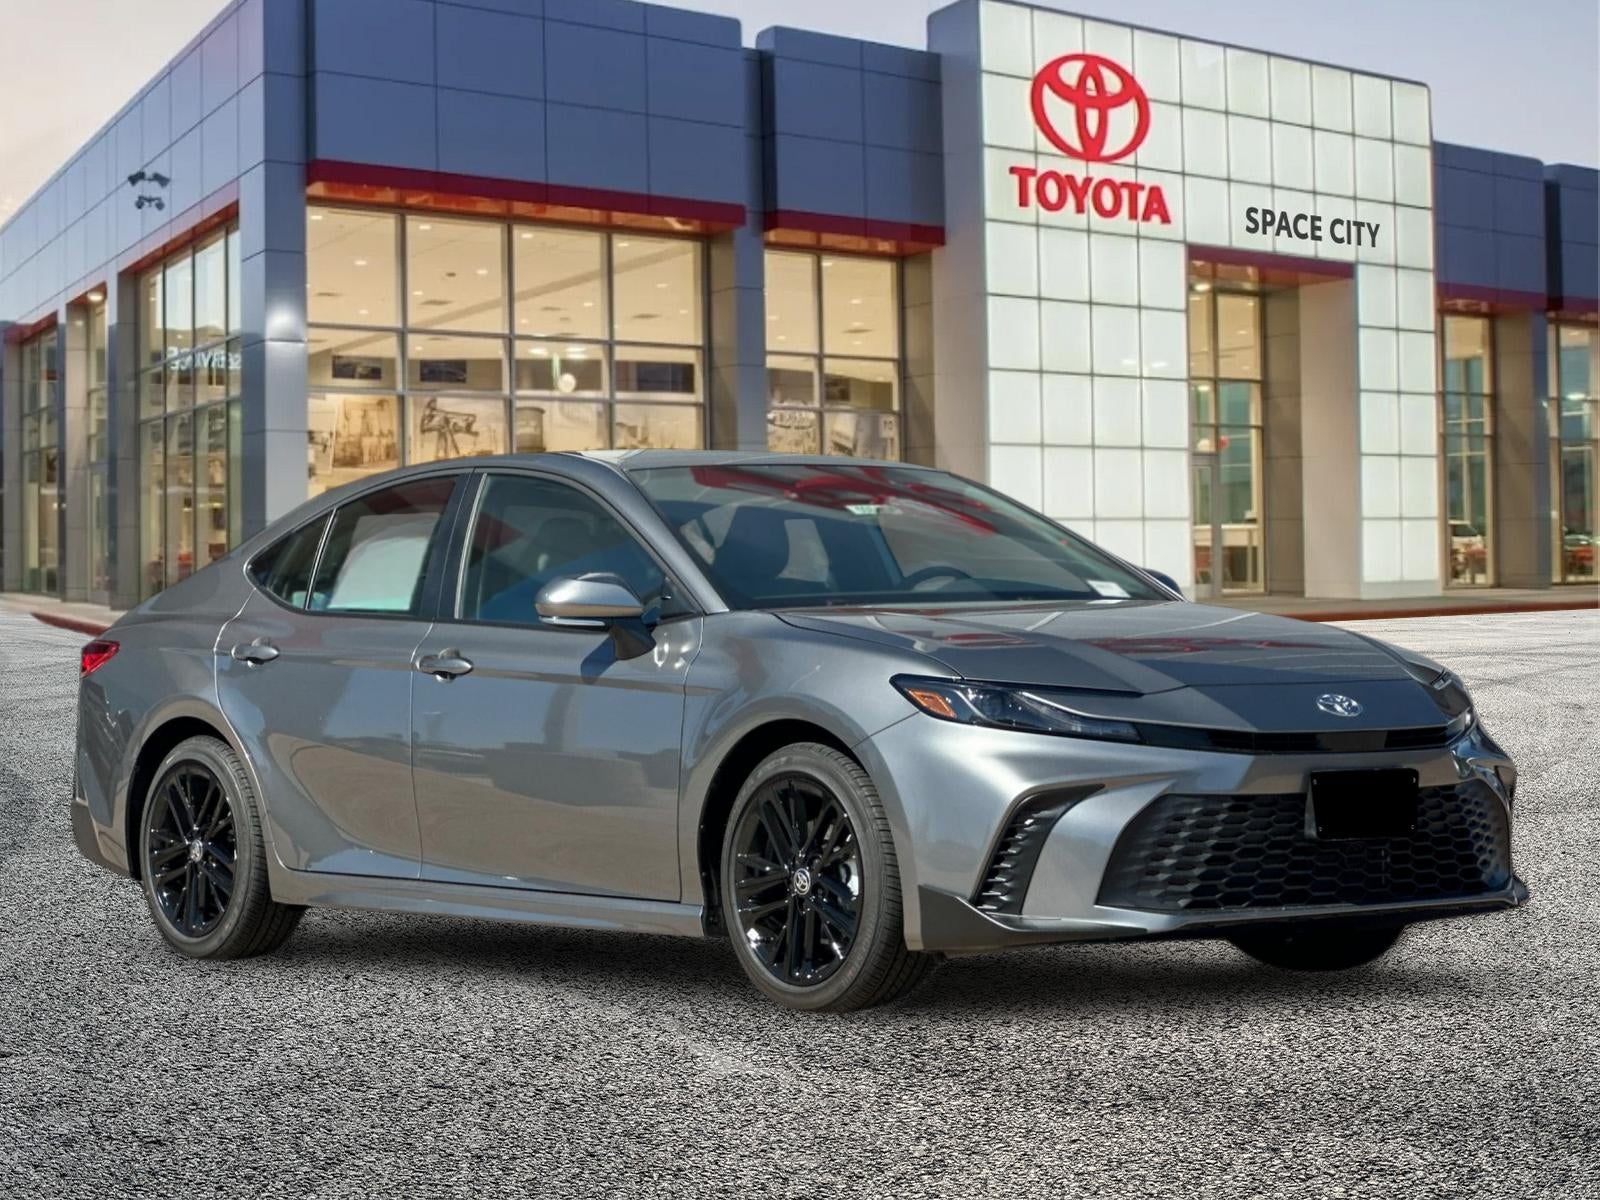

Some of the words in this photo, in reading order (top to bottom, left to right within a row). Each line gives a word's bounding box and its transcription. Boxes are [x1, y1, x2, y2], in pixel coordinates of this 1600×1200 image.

[1009, 166, 1171, 225] TOYOTA
[1245, 206, 1323, 242] SPACE
[1329, 218, 1381, 248] CITY
